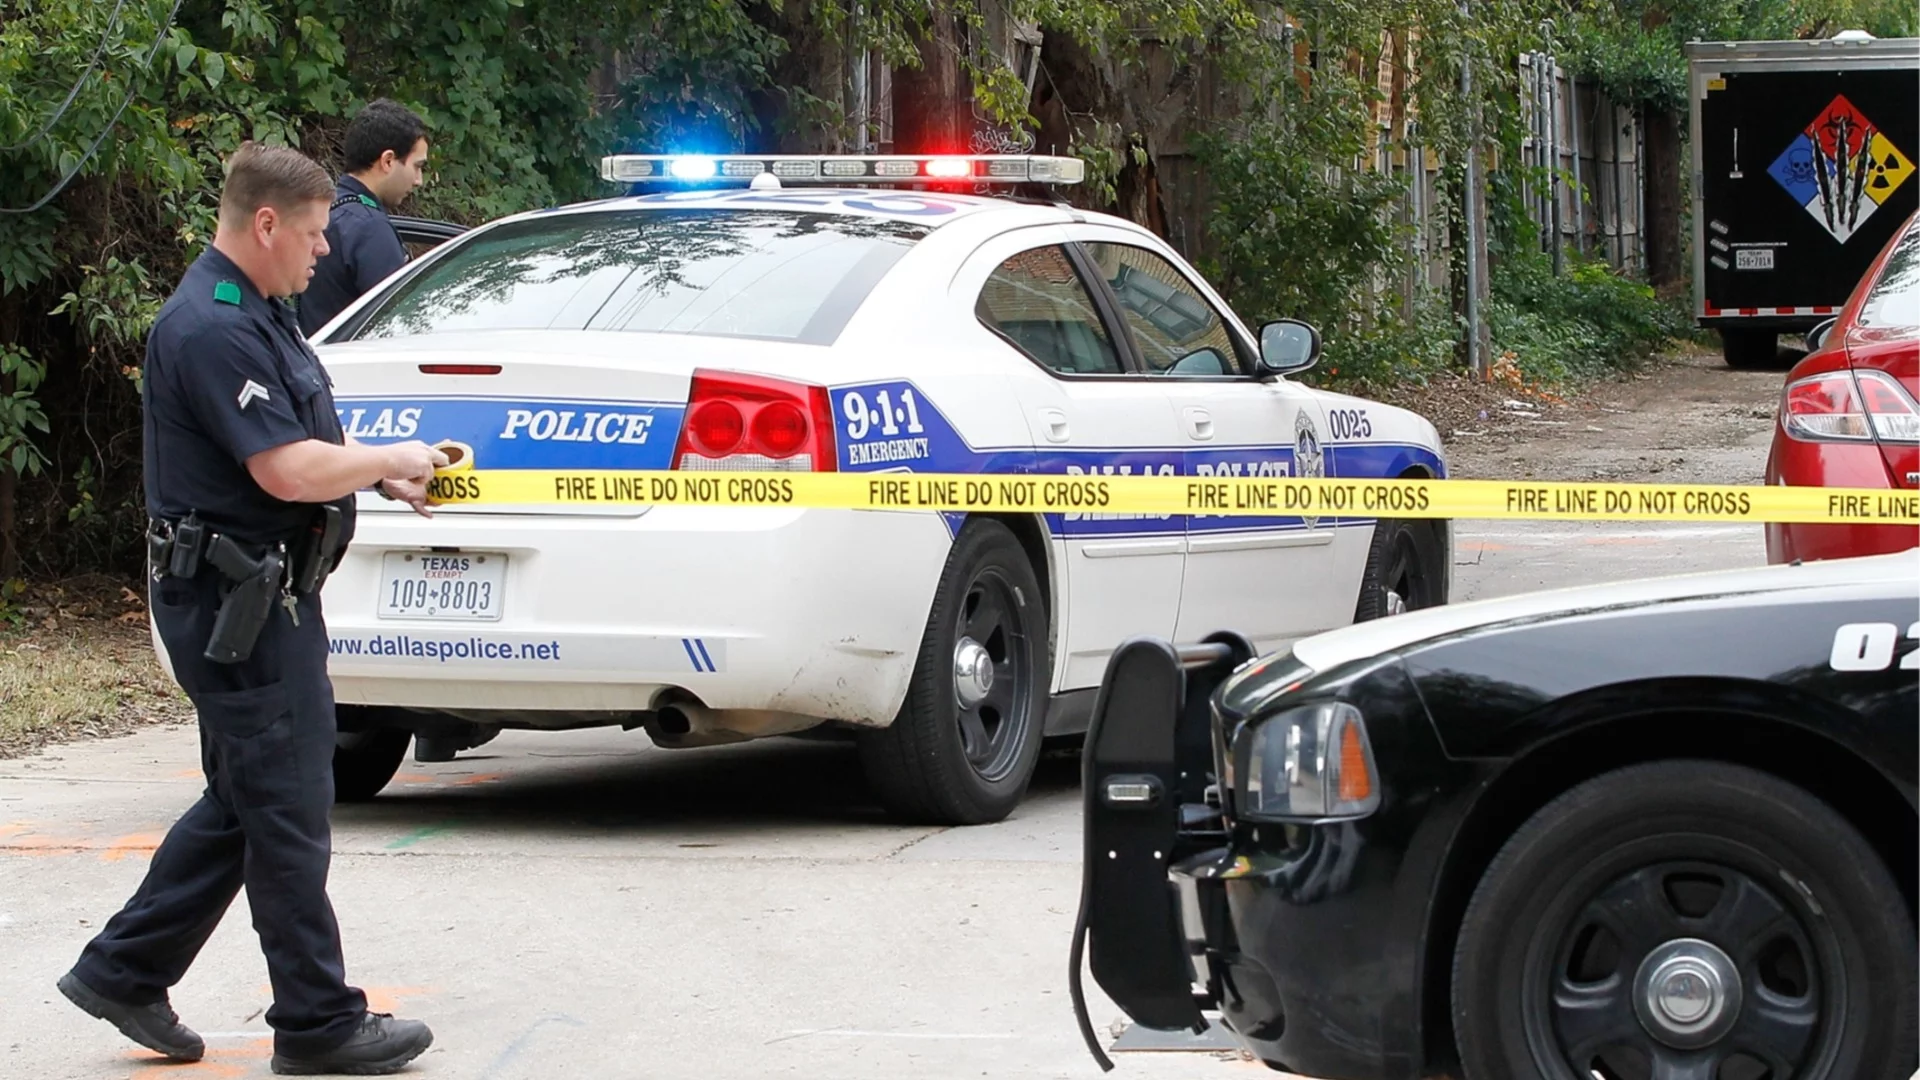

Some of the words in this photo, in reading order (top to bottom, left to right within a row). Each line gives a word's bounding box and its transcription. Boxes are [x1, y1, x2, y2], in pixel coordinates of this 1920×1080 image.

[499, 409, 654, 444] POLICE
[1330, 409, 1372, 440] 0025
[848, 438, 929, 465] EMERGENCY
[427, 475, 480, 499] ROSS
[555, 477, 597, 500] FIRE
[603, 477, 644, 501] LINE
[652, 477, 678, 501] DO
[685, 478, 721, 502] NOT
[728, 478, 794, 503] CROSS
[869, 480, 911, 505] FIRE
[917, 480, 959, 505] LINE
[966, 481, 993, 506] DO
[1000, 481, 1037, 506] NOT
[1043, 481, 1110, 506] CROSS
[1187, 483, 1229, 508] FIRE
[1236, 484, 1277, 508] LINE
[1285, 485, 1312, 509] DO
[1319, 485, 1357, 509] NOT
[1363, 485, 1430, 511] CROSS
[1507, 488, 1549, 512] FIRE
[1556, 489, 1597, 513] LINE
[1605, 490, 1632, 513] DO
[1639, 491, 1677, 514] NOT
[1683, 491, 1751, 515] CROSS
[1828, 495, 1871, 517] FIRE
[1878, 495, 1919, 518] LINE
[421, 557, 470, 571] TEXAS
[424, 570, 463, 579] EXEMPT
